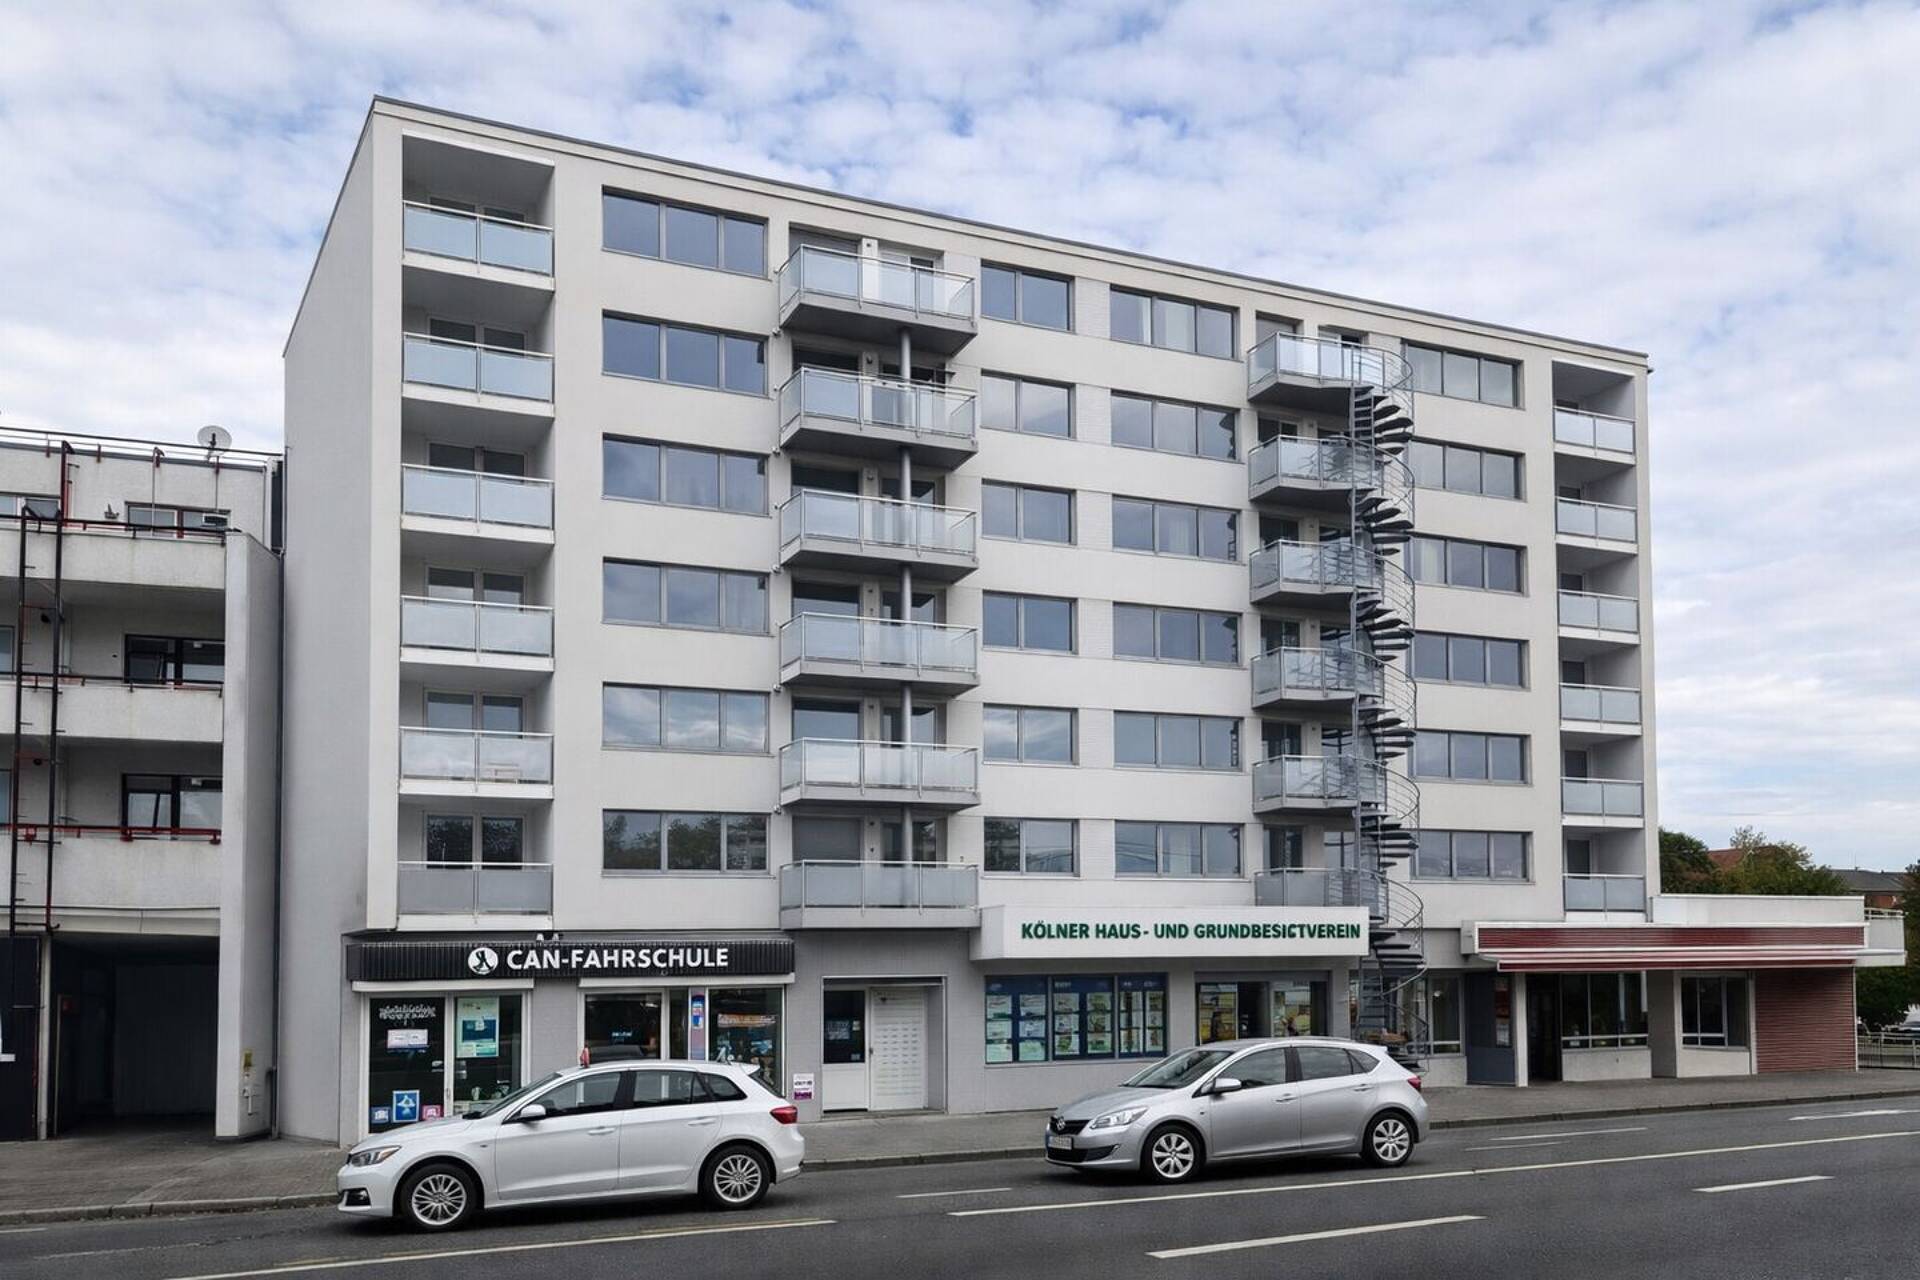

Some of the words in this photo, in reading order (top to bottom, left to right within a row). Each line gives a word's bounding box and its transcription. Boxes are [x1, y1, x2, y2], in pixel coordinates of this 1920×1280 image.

[1021, 920, 1089, 939] KÖLNER
[1154, 923, 1189, 939] UND
[506, 948, 729, 970] CAN-FAHRSCHULE
